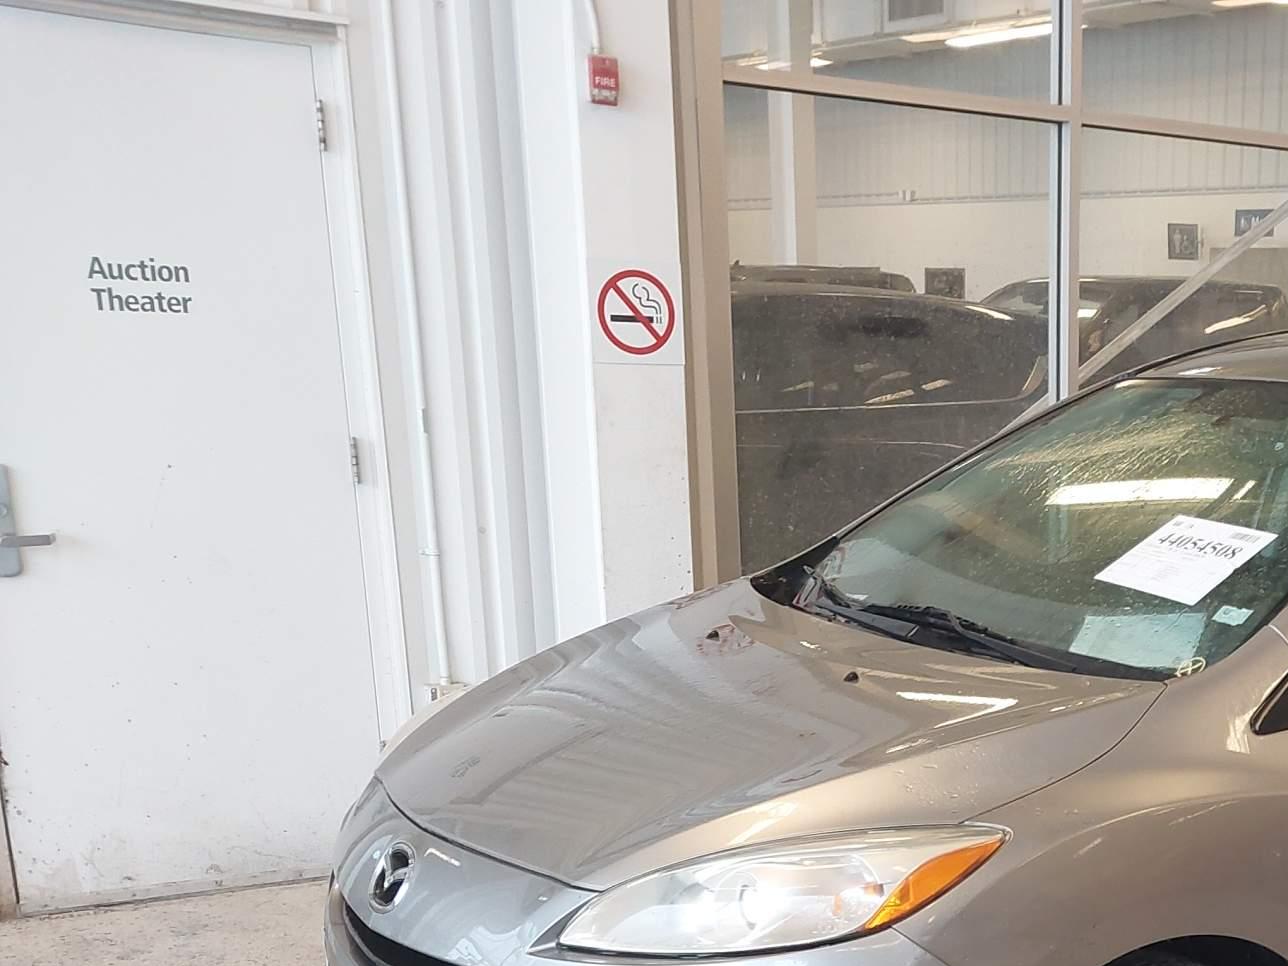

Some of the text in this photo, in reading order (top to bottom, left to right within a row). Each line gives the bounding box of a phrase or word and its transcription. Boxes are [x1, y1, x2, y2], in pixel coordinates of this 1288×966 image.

[594, 76, 617, 88] FIRE
[88, 256, 190, 283] Auction
[90, 287, 192, 313] Theater
[1158, 533, 1244, 560] 44054508
